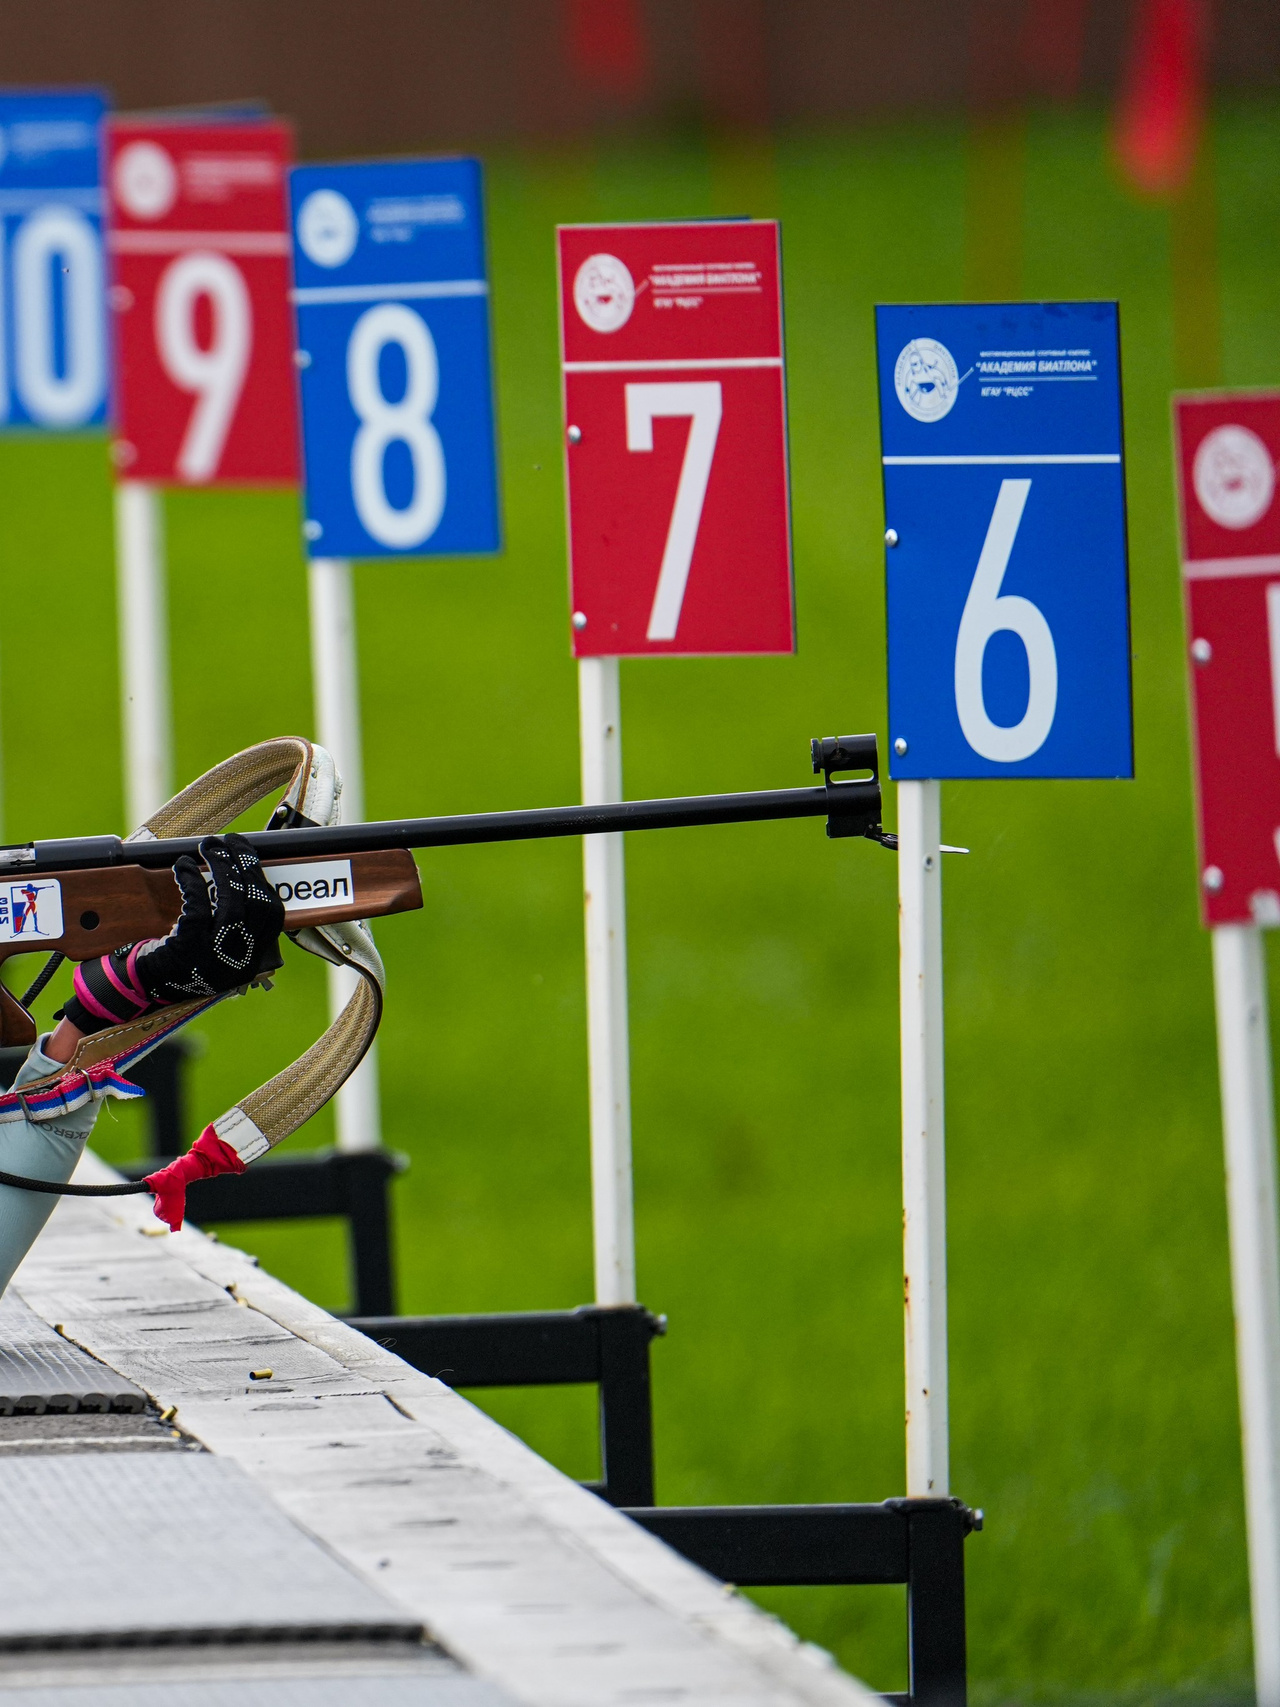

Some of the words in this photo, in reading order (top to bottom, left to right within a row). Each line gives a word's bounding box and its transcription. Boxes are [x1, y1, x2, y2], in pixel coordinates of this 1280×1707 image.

[155, 252, 253, 484] 9
[346, 302, 447, 549] 8
[625, 381, 723, 641] 7
[954, 478, 1058, 763] 6
